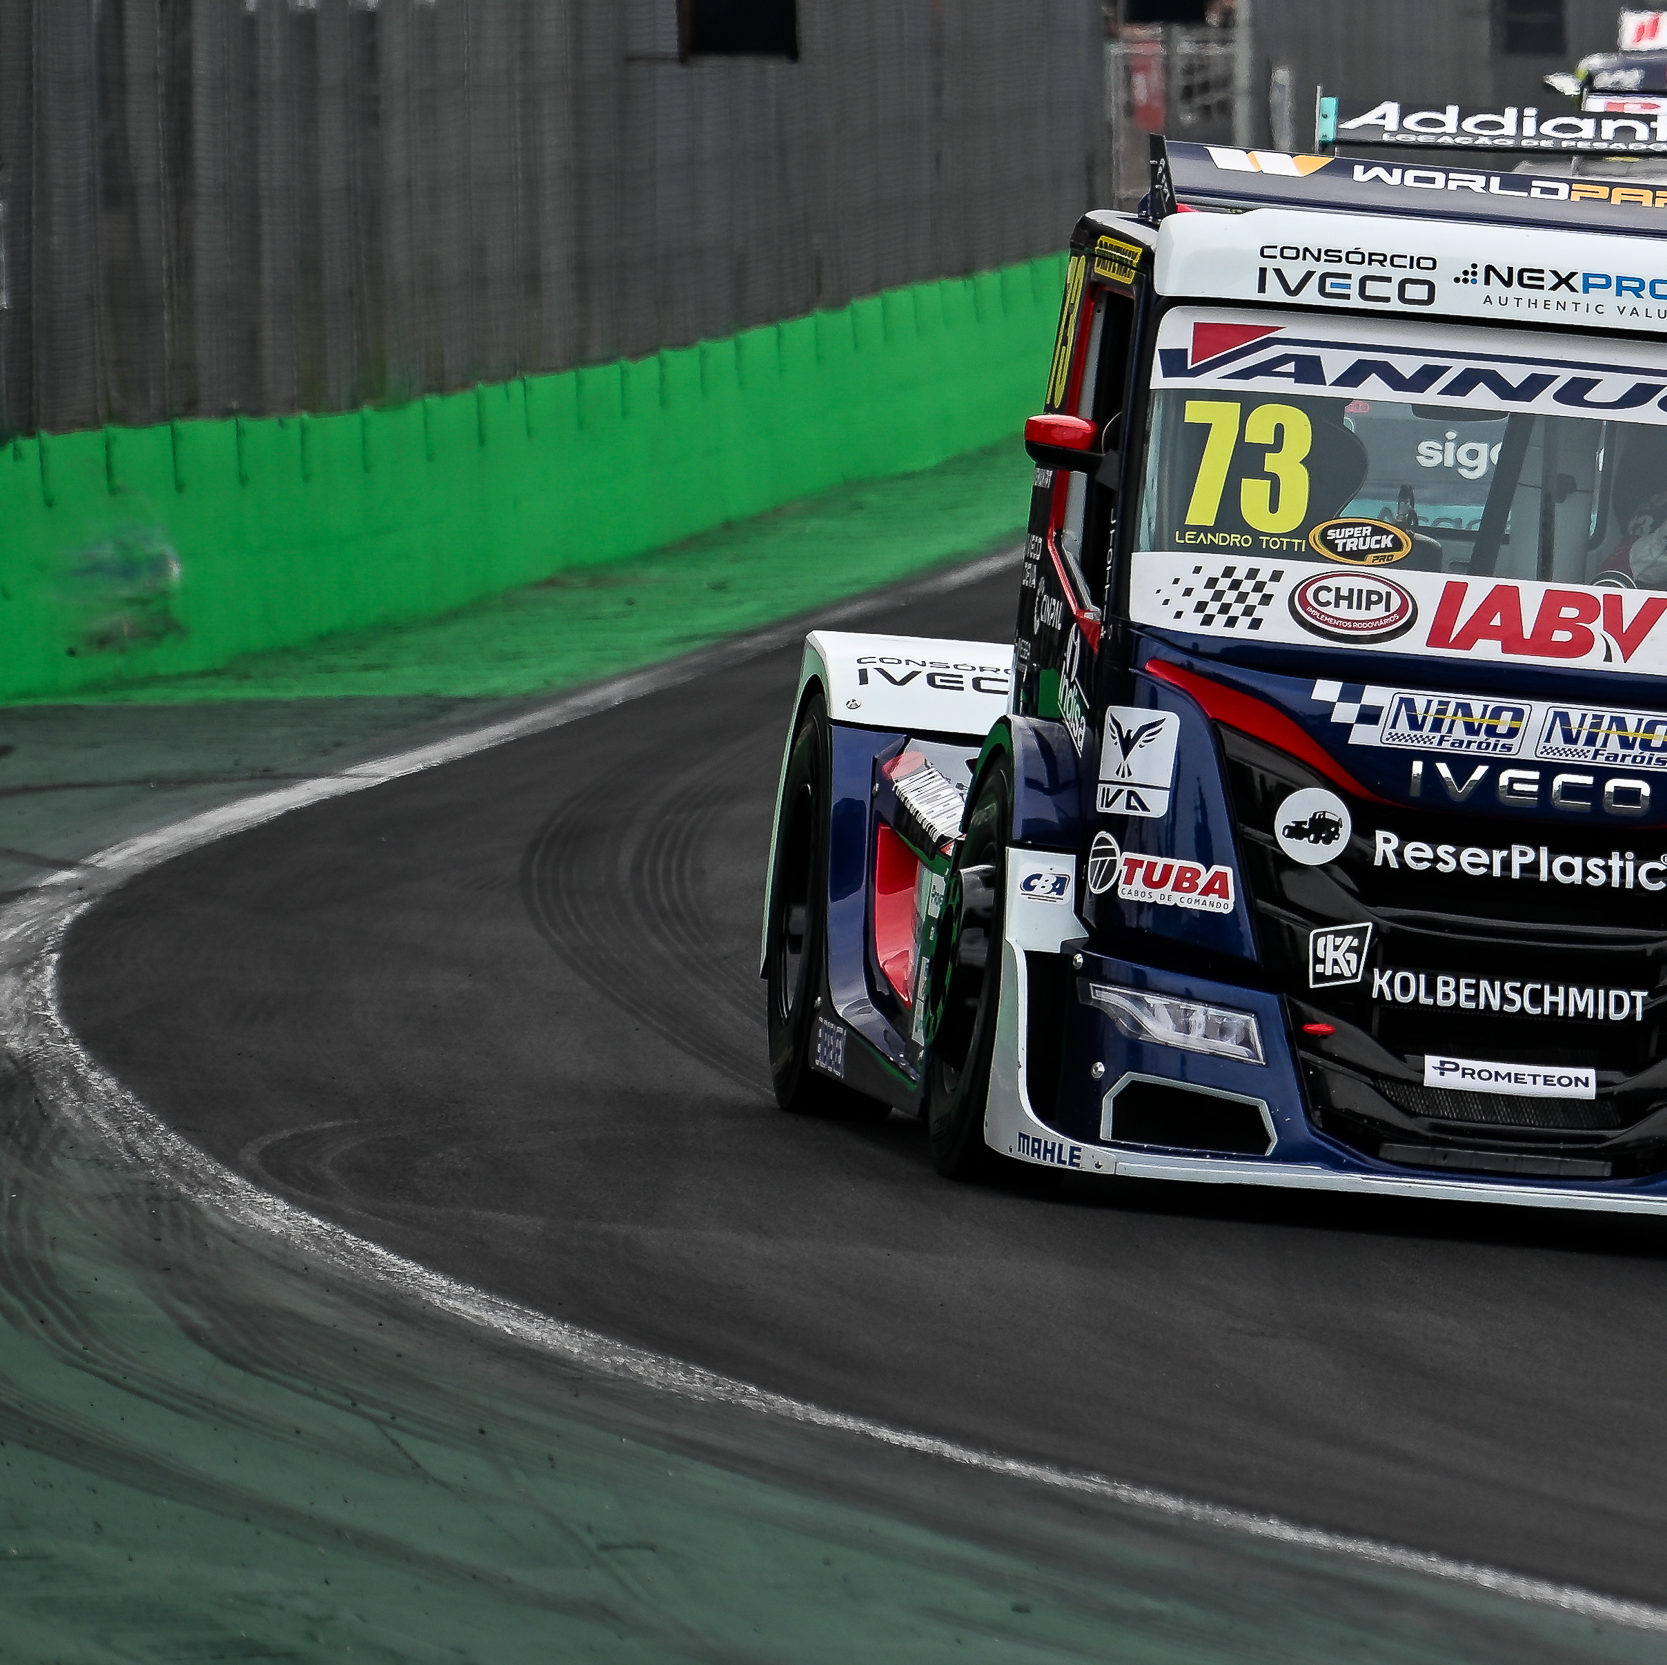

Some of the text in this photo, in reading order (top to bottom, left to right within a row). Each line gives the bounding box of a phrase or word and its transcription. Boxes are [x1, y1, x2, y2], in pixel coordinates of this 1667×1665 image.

[1259, 245, 1438, 271] CONSÓRCIO
[1258, 267, 1436, 306] IVECO
[1483, 295, 1605, 316] AUTHENTIC
[1184, 400, 1312, 534] 73
[1175, 531, 1306, 552] LEANDRO TOTTI
[1327, 526, 1371, 540] SUPER
[1335, 534, 1394, 551] TRUCK
[1371, 554, 1395, 565] PRO
[1313, 585, 1392, 613] CHIPI
[1306, 606, 1400, 629] IMPLEMENTOS RODOVIÁRIOS
[1437, 735, 1513, 754] Faróis
[1590, 746, 1667, 766] Faróis
[1411, 760, 1652, 812] IVECO
[1020, 873, 1069, 895] CBA
[1121, 857, 1231, 900] TUBA
[1121, 888, 1229, 911] CABOS DE COMANDO
[1371, 968, 1648, 1021] KOLBENSCHMIDT
[1433, 1059, 1591, 1089] PROMETEON
[1018, 1132, 1082, 1168] MAHLE
